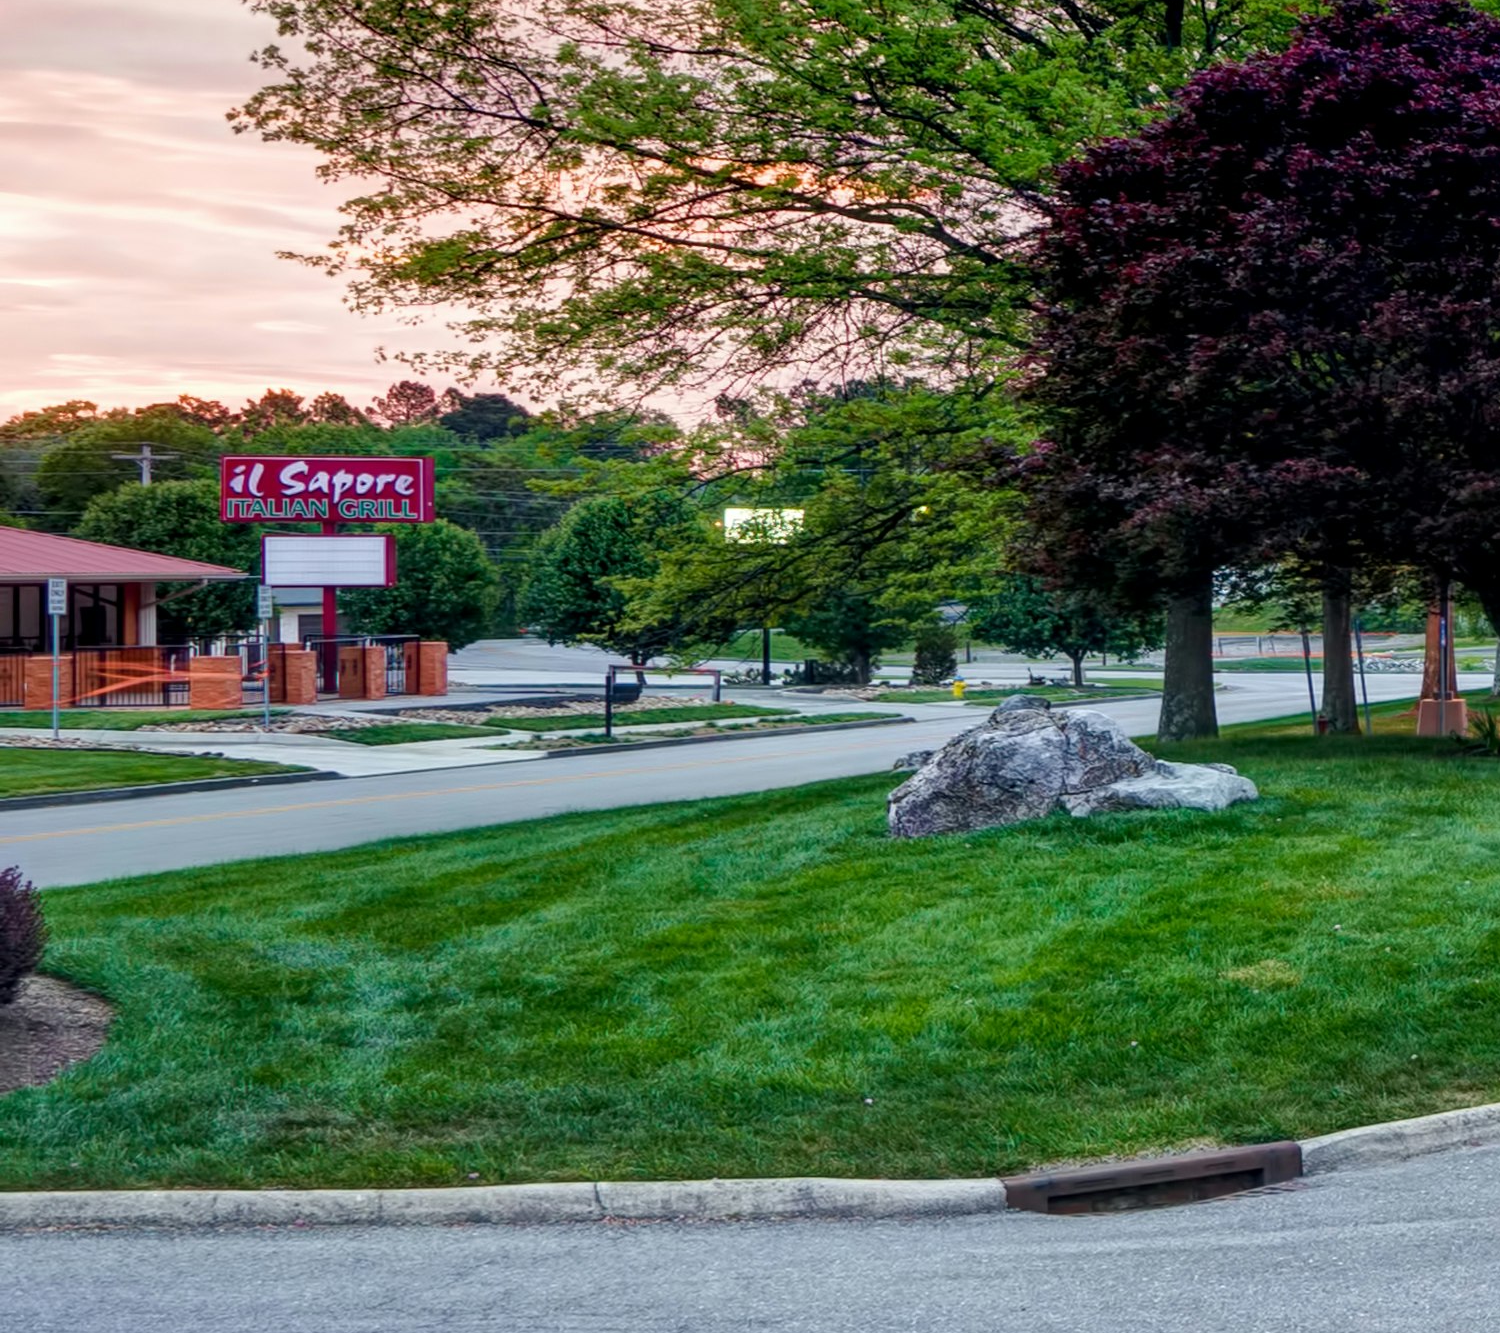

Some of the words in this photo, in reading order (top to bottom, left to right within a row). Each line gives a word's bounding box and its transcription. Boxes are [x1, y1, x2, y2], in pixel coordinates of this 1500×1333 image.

[229, 463, 264, 497] il
[279, 461, 414, 504] Sapore
[227, 498, 329, 518] ITALIAN
[338, 498, 417, 519] GRILL
